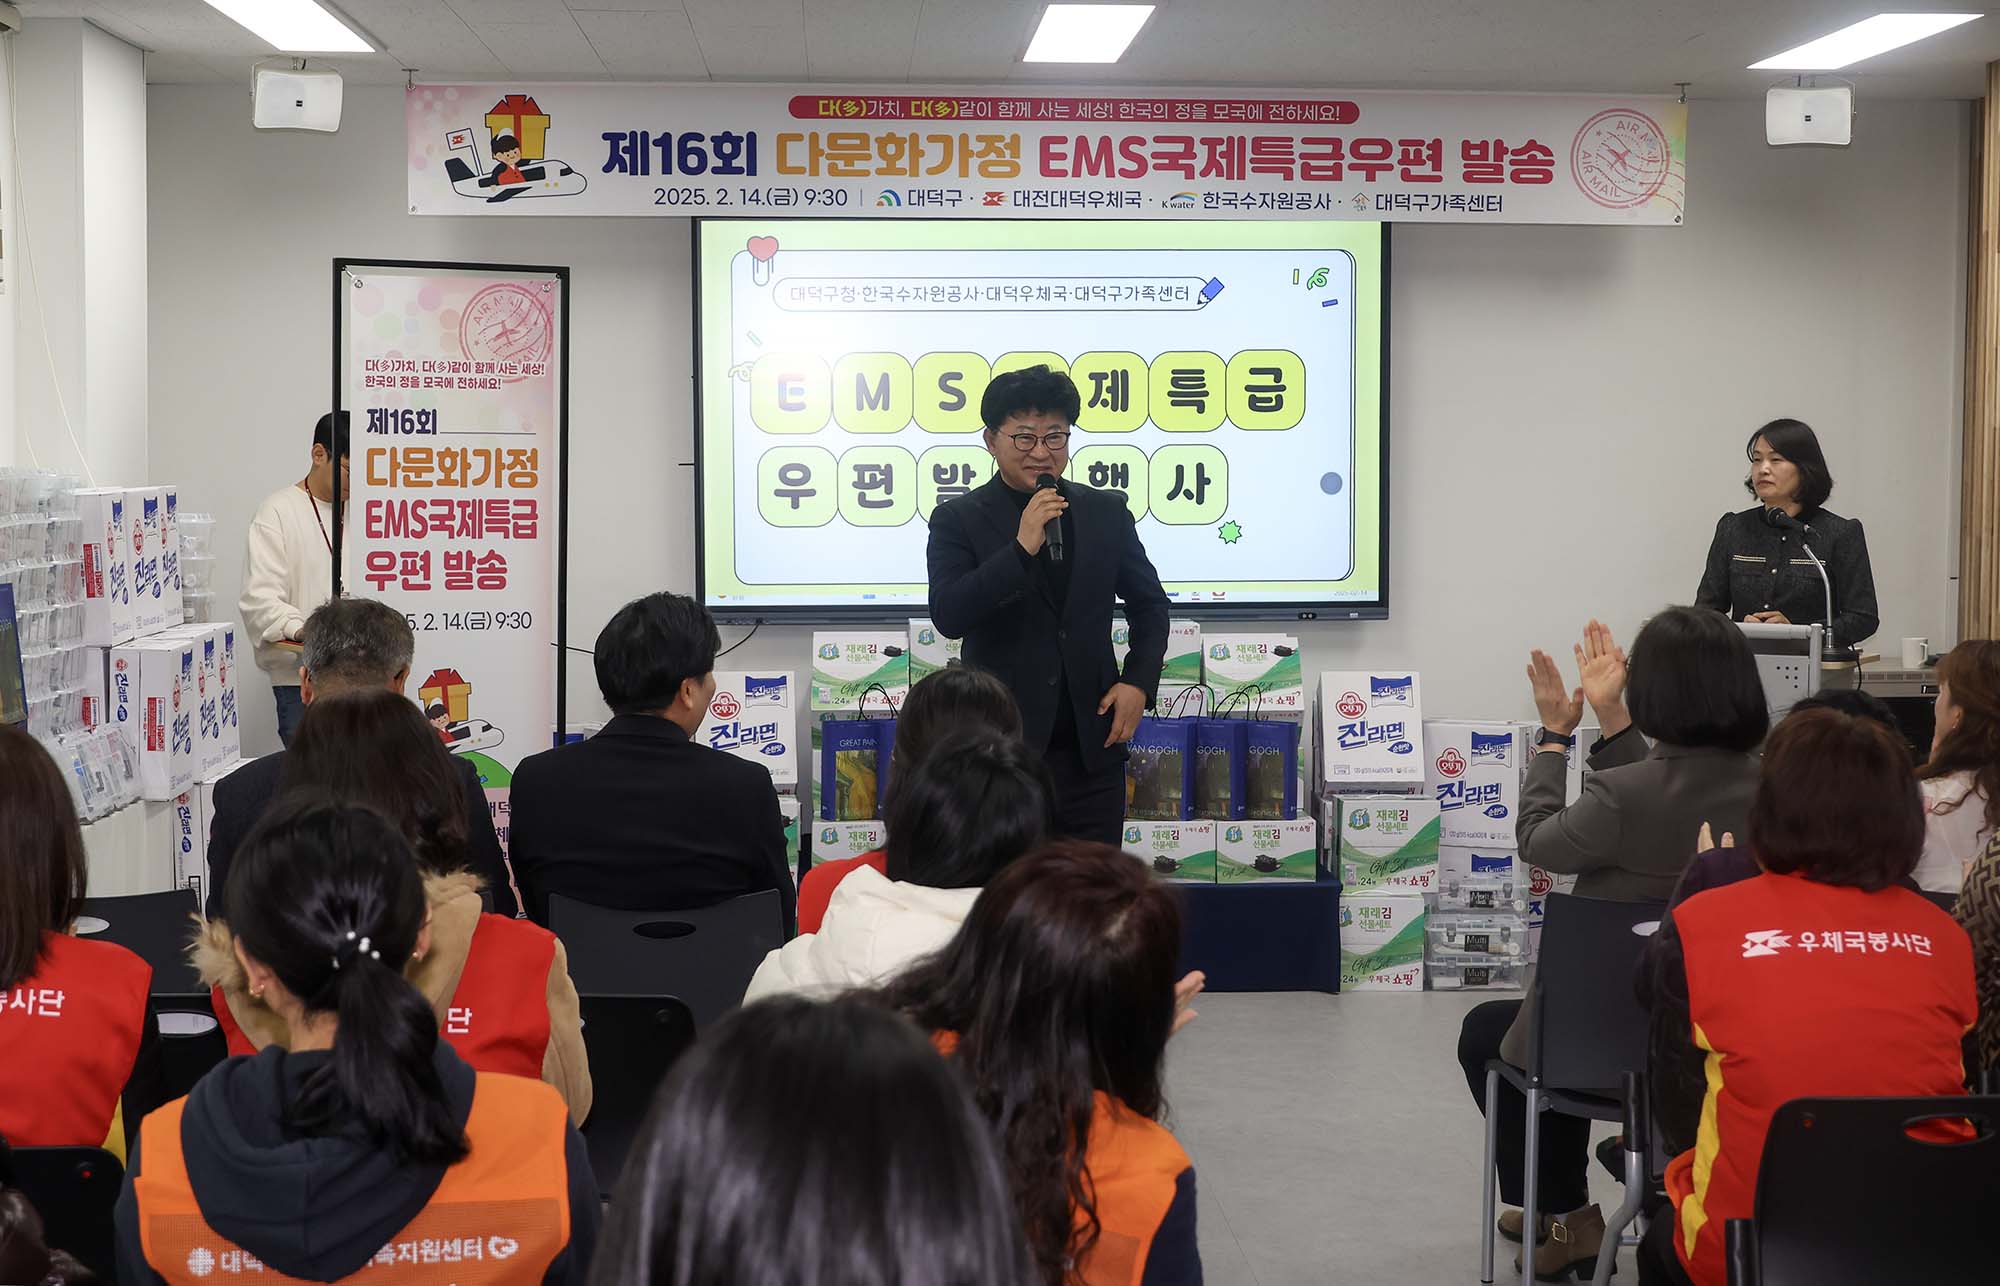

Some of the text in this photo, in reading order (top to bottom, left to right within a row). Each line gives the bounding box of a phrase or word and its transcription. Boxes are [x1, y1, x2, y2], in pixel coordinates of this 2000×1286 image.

[818, 100, 1340, 121] 다(多)가치, 다(多)같이 함께 사는 세상! 한국의 정을 모국에 전하세요!
[601, 130, 1555, 184] 제16회 다문화가정 EMS국제특급우편 발송
[1590, 176, 1621, 197] MAIL
[653, 187, 848, 207] 2025. 2. 14.(금) 9:30
[908, 189, 963, 207] 대덕구
[1013, 190, 1141, 209] 대전대덕우체국
[1169, 200, 1195, 209] water
[1203, 191, 1331, 210] 한국수자원공사
[1375, 194, 1503, 212] 대덕구가족센터
[365, 359, 545, 376] 다(多)가치, 다(多)같이 함께 사는 세상!
[365, 375, 502, 390] 한국의 정을 모국에 전하세요!
[366, 408, 438, 435] 제16회
[365, 446, 539, 489] 다문화가정
[365, 499, 539, 540] EMS국제특급
[365, 549, 508, 592] 우편 발송
[423, 613, 439, 631] 2.
[442, 612, 492, 631] 14.(금)
[496, 611, 532, 630] 9:30
[709, 720, 778, 751] 진라면
[839, 739, 861, 747] GREAT
[1336, 720, 1405, 751] 진라면
[1148, 745, 1178, 755] GOGH
[1197, 745, 1226, 755] GOGH
[1249, 745, 1280, 755] GOGH
[1436, 780, 1502, 811] 진라면
[1376, 809, 1409, 822] 재래김
[848, 831, 877, 842] 재래김
[1152, 829, 1180, 841] 재래김
[1252, 829, 1281, 840] 재래김
[1409, 875, 1430, 887] 쇼핑
[1359, 907, 1392, 920] 재래김
[1797, 930, 1933, 957] 우체국봉사단
[1392, 973, 1413, 985] 쇼핑
